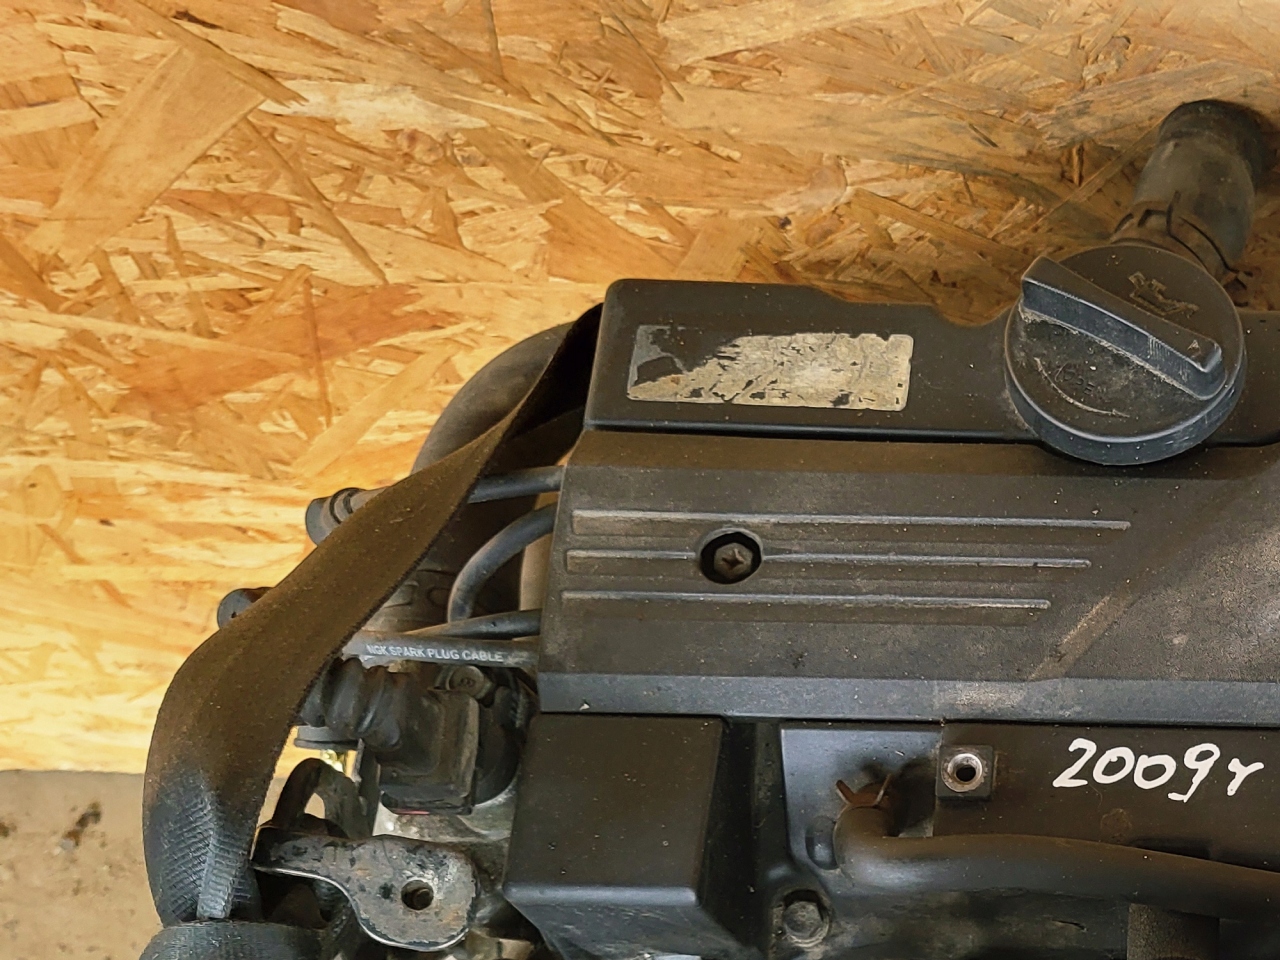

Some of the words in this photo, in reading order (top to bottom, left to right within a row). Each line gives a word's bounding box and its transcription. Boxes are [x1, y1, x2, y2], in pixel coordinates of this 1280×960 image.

[366, 644, 387, 656] NGK
[389, 645, 425, 658] SPARK
[427, 647, 460, 660] PLUG
[462, 649, 504, 662] CABLE
